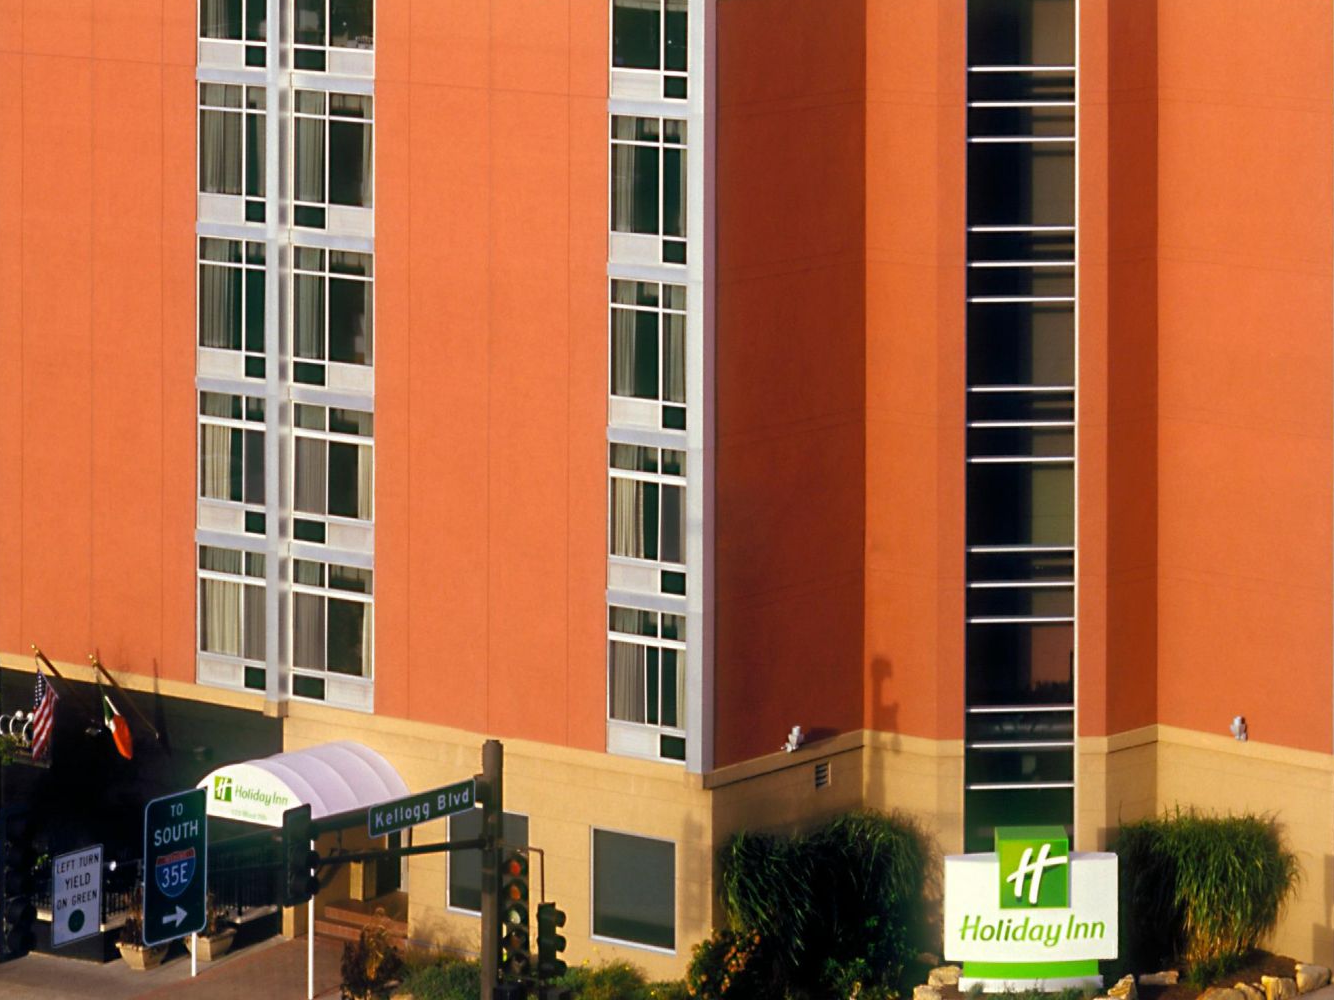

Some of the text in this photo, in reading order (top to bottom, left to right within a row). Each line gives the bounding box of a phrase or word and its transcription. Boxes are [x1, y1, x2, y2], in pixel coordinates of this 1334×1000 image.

[235, 784, 288, 806] Holiday Inn
[171, 803, 183, 816] TO
[375, 788, 469, 828] Kellogg Blvd
[154, 819, 198, 846] SOUTH
[56, 853, 99, 874] LEFT TURN
[65, 872, 91, 890] YIELD
[161, 862, 188, 888] 35E
[57, 889, 97, 910] ON GREEN
[959, 914, 1106, 947] Holiday Inn
